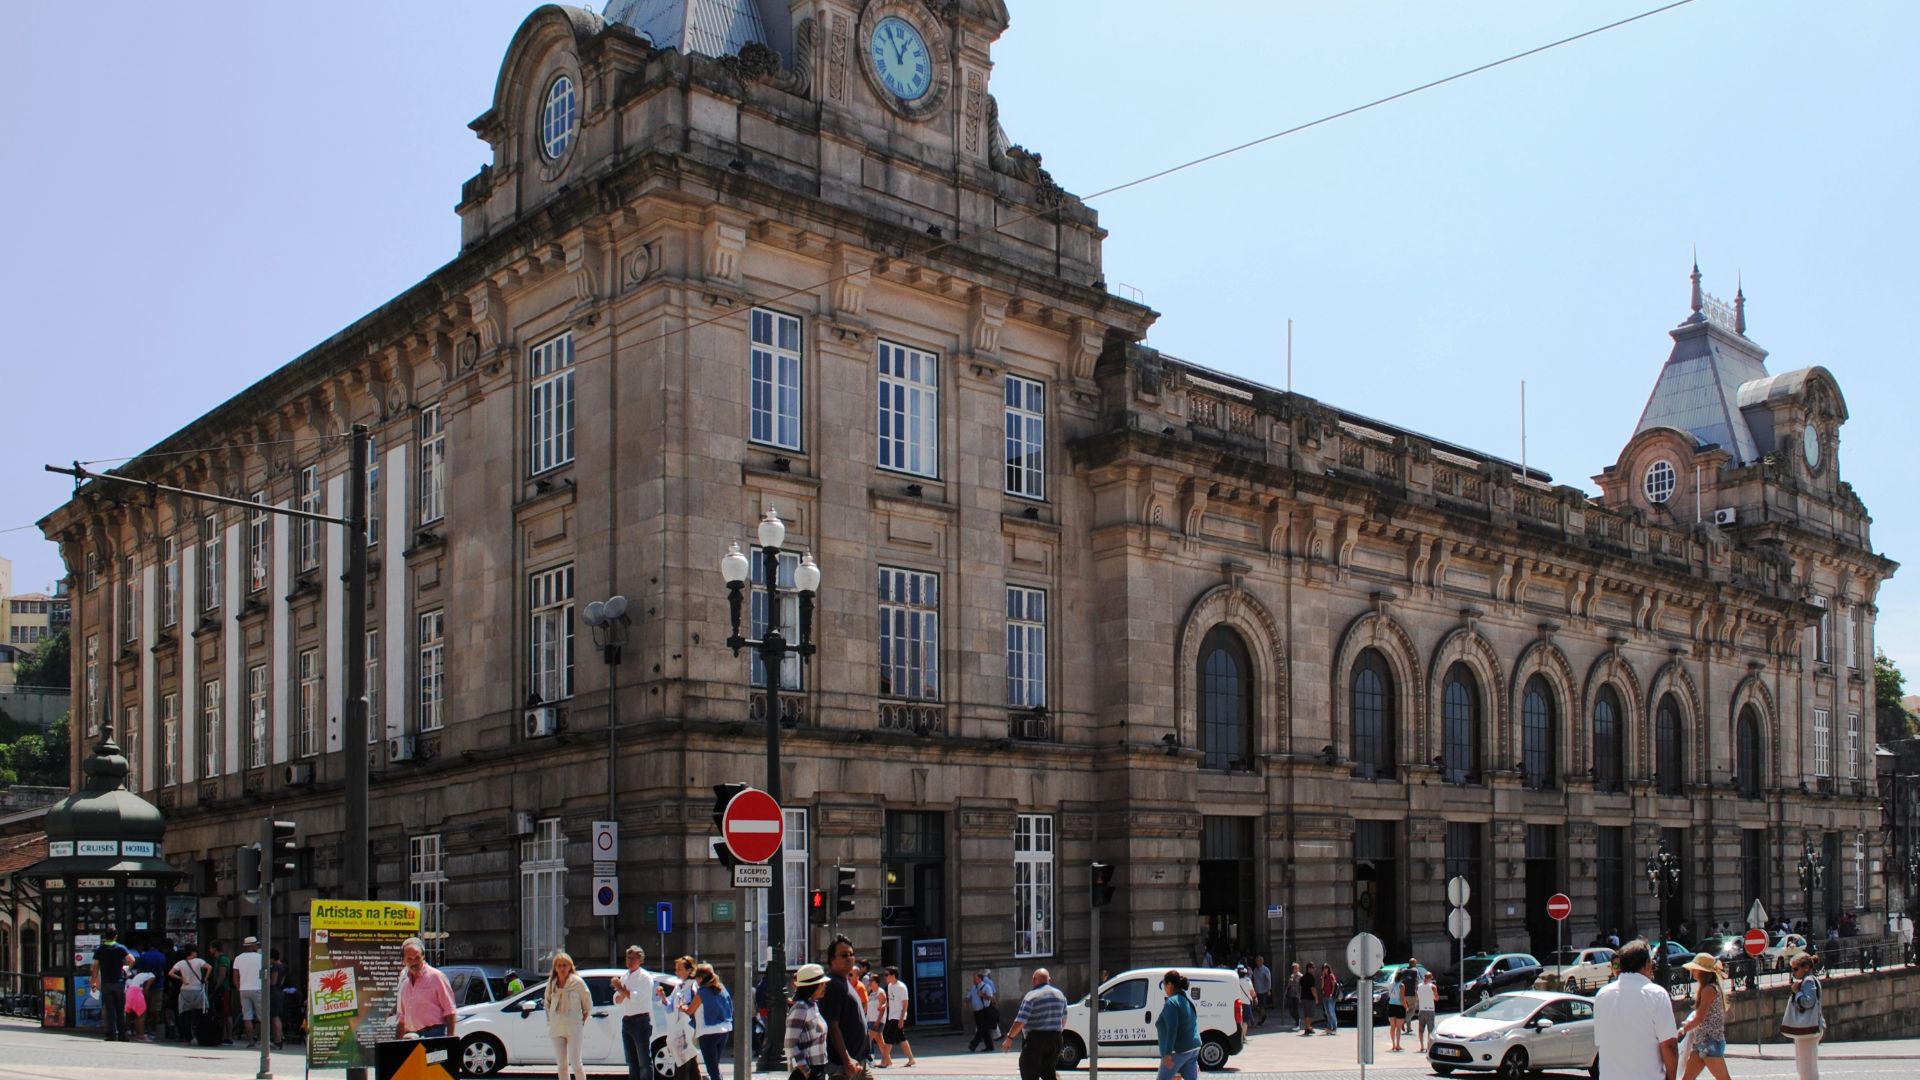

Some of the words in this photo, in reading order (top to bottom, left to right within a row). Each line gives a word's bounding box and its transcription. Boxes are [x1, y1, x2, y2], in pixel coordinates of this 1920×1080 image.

[80, 844, 115, 852] CRUISES
[125, 845, 150, 853] HOTELS
[736, 876, 771, 884] ELÉCTRICO
[316, 905, 363, 919] Artistas
[366, 908, 380, 919] na
[384, 907, 416, 920] Festa
[314, 987, 355, 1006] Festa
